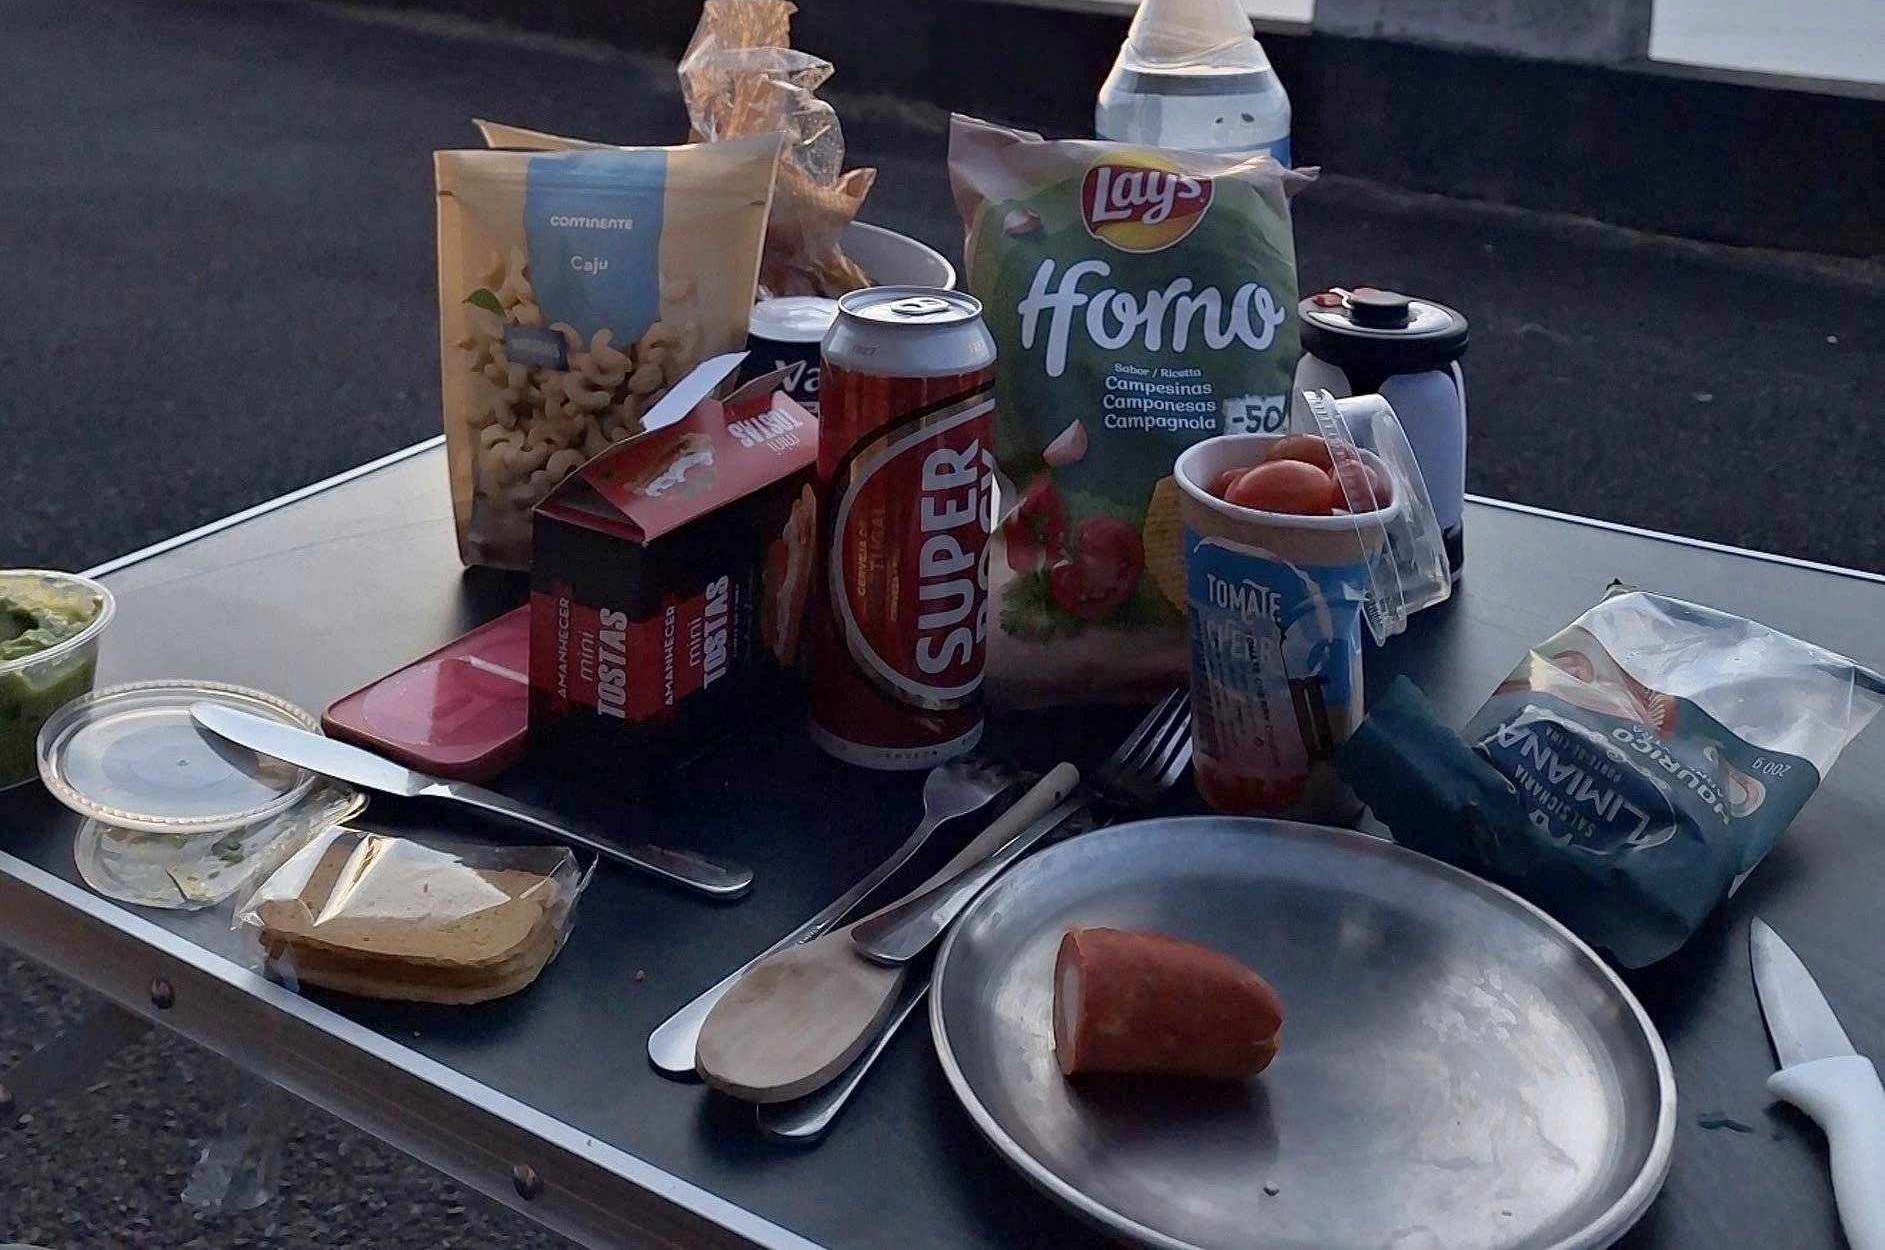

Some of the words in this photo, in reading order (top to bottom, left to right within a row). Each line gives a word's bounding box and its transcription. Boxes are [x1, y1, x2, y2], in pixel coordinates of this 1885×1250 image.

[570, 255, 609, 276] Caju
[1017, 257, 1285, 378] Forno
[1104, 375, 1213, 396] Campesinas
[1113, 362, 1150, 375] Sabor
[1160, 367, 1202, 378] Ricetta
[727, 408, 804, 448] TOSTAS
[1102, 394, 1217, 413] Camponesas
[1103, 413, 1217, 432] Campagnola
[857, 541, 868, 597] CERVEJA
[916, 438, 979, 675] SUPER
[1206, 573, 1283, 617] TOMATE
[558, 597, 570, 699] AMANHECER
[577, 631, 594, 681] mini
[664, 605, 676, 706] AMANHECER
[687, 617, 702, 667] mini
[703, 575, 729, 689] TOSTAS
[597, 608, 627, 718] TOSTAS
[1497, 722, 1651, 840] LIMIANA
[1751, 755, 1763, 770] g
[1762, 760, 1791, 779] 200
